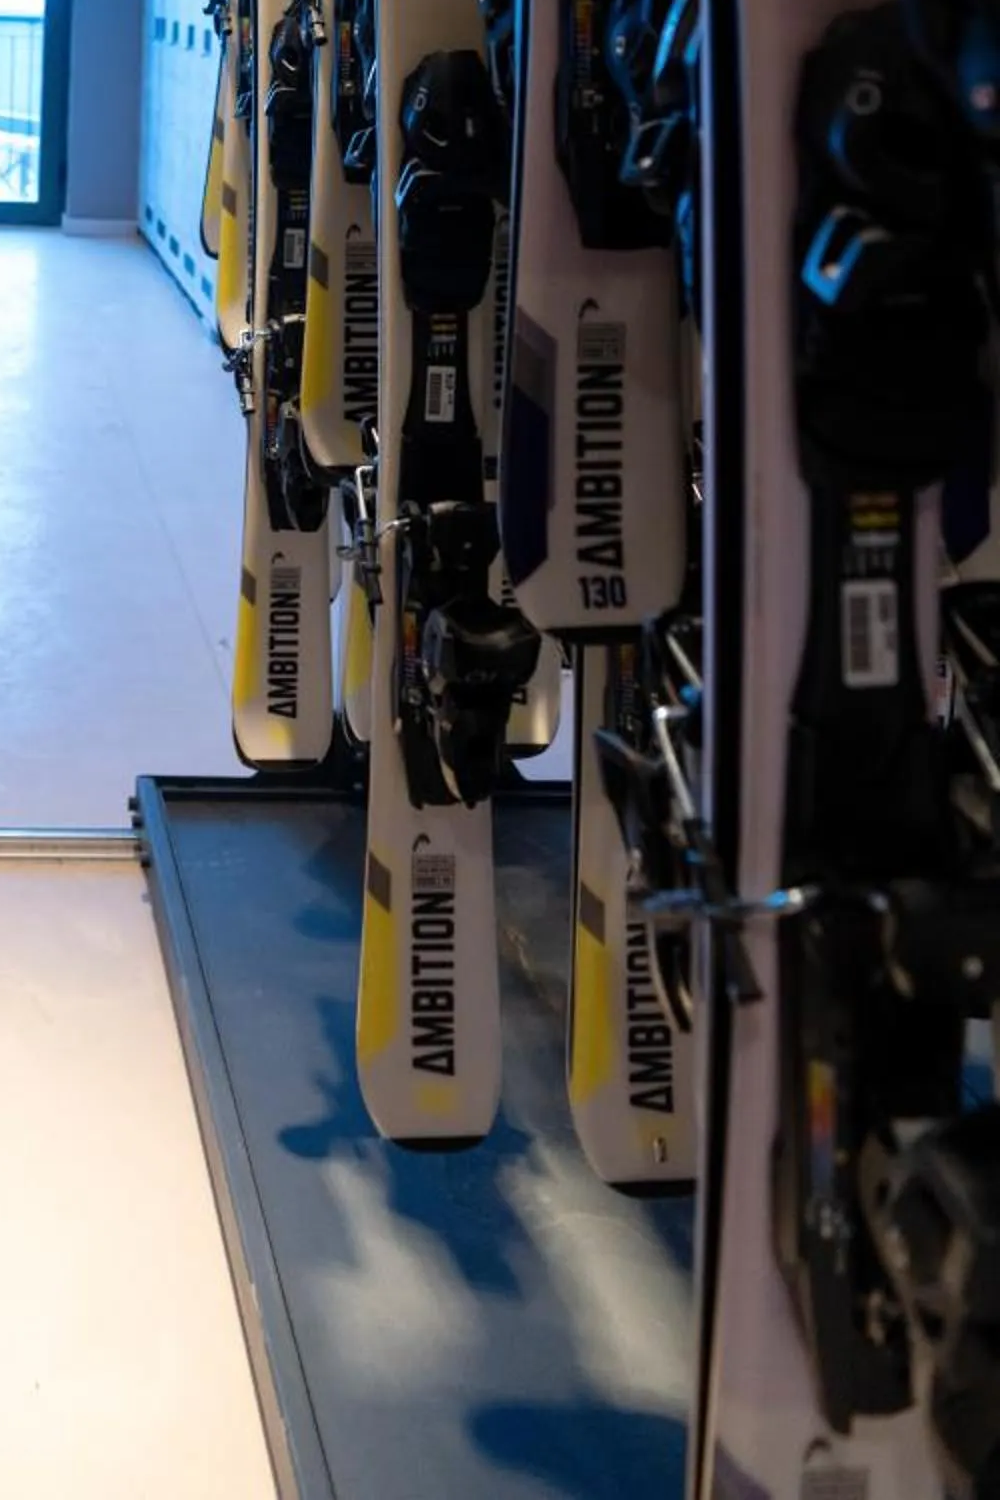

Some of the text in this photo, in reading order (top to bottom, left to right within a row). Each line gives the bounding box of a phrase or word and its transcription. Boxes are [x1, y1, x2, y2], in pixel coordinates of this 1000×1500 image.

[344, 274, 378, 421] AMBITION
[575, 364, 624, 570] AMBITION
[267, 591, 300, 718] AMBITION
[578, 576, 627, 610] 130
[412, 891, 455, 1076] AMBITION
